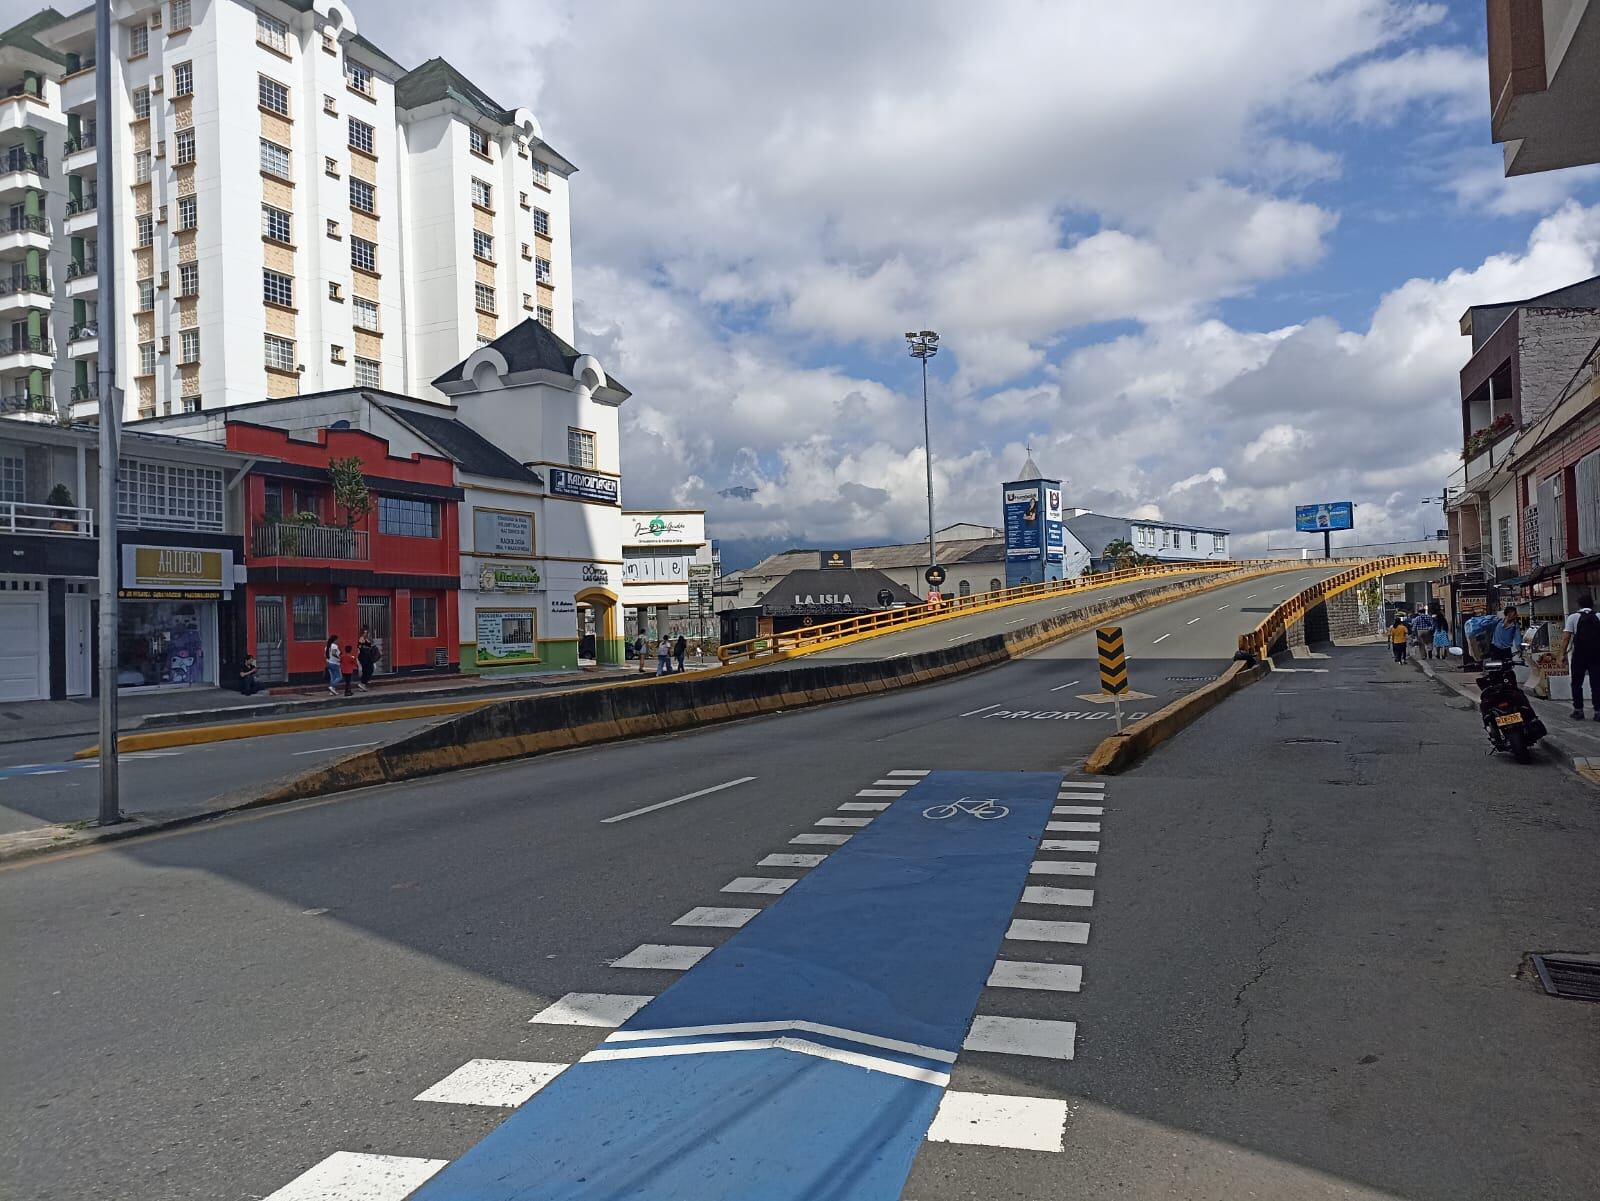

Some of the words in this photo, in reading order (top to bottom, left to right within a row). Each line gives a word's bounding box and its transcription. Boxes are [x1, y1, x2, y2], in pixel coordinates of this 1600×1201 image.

[567, 472, 616, 492] RADIOIMAGEN
[158, 549, 202, 574] ARTDECO
[794, 594, 815, 605] LA
[819, 594, 853, 605] ISLA
[981, 710, 1151, 720] PRIORIDAD
